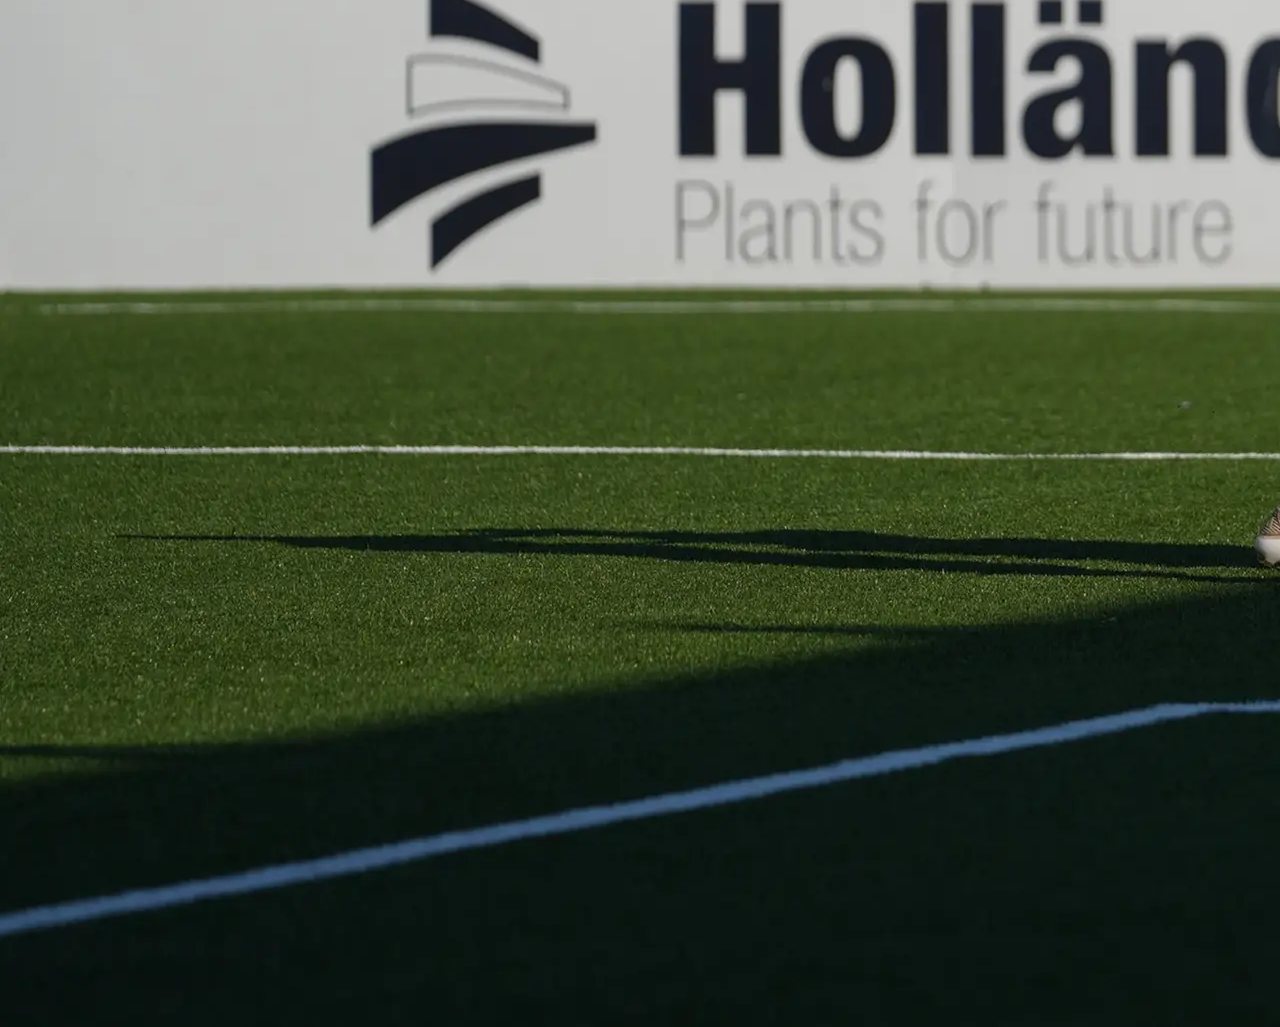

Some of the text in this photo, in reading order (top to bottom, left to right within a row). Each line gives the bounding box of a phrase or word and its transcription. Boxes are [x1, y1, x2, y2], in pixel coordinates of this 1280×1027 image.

[674, 179, 1233, 268] Plants for future
